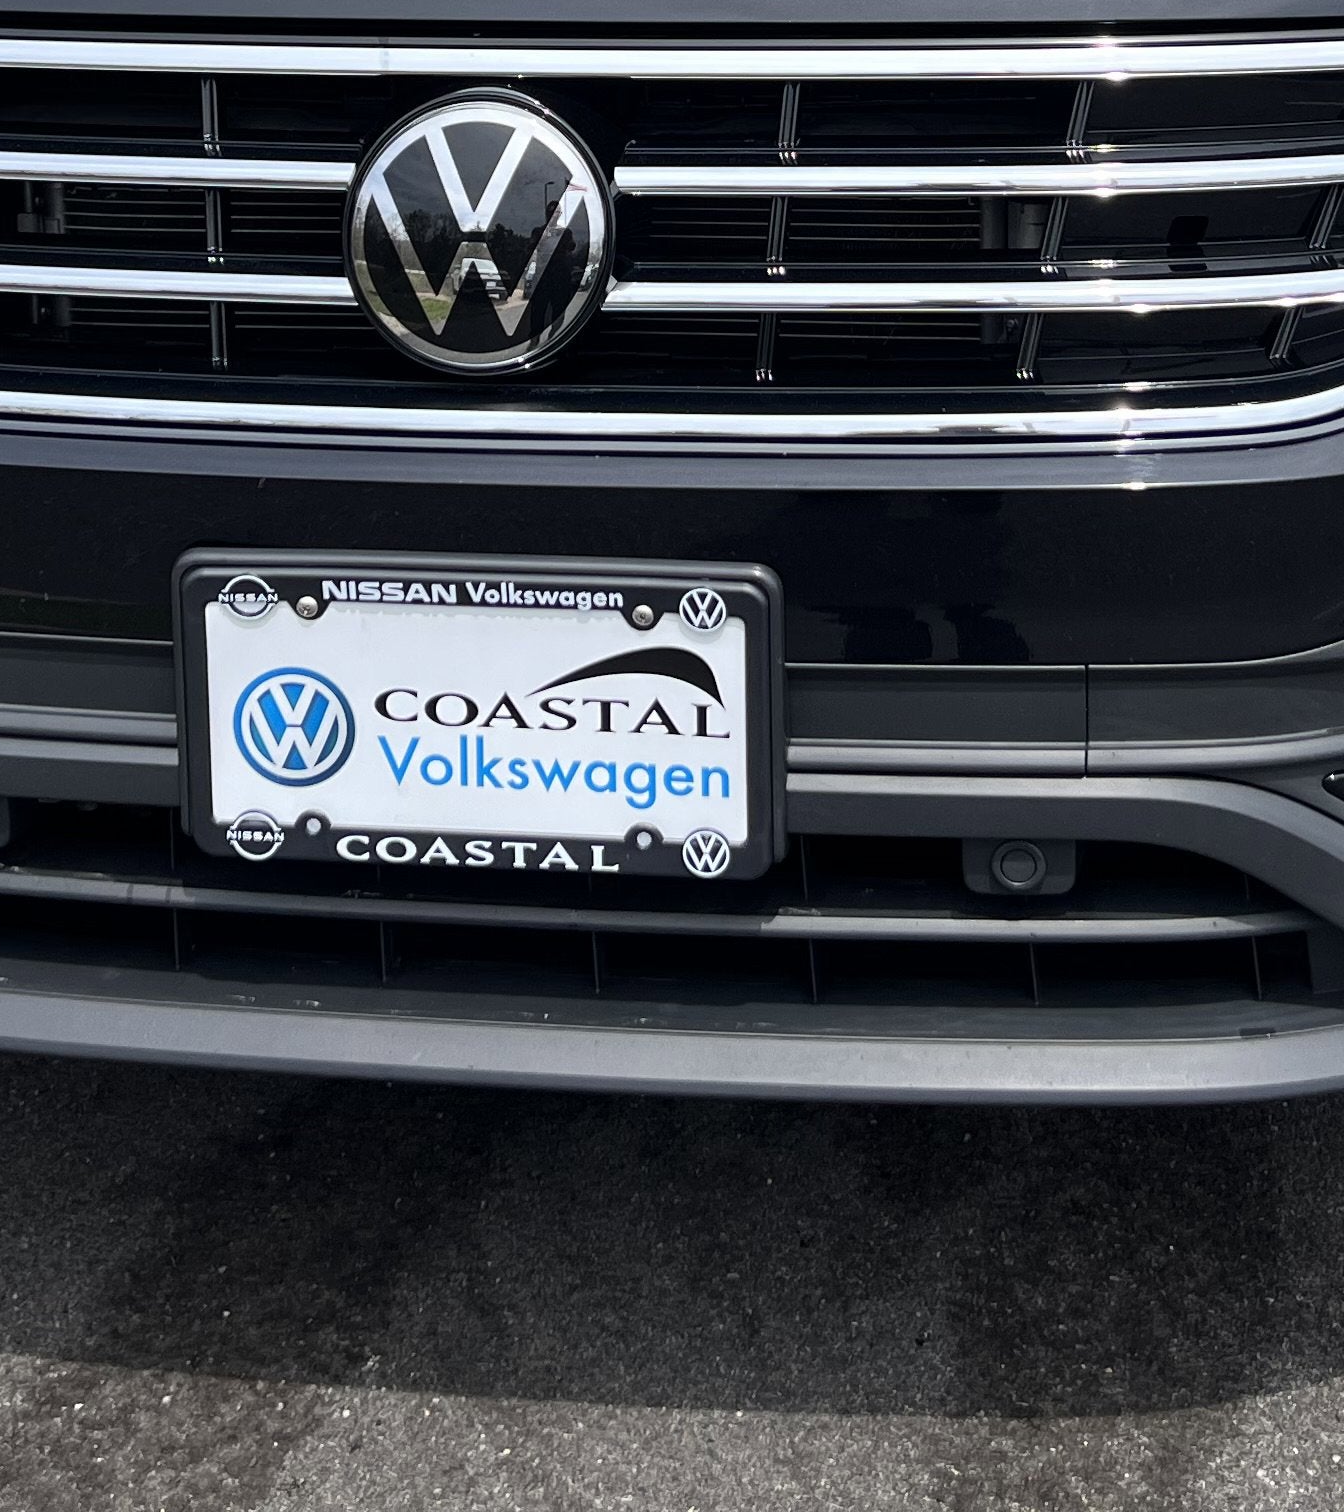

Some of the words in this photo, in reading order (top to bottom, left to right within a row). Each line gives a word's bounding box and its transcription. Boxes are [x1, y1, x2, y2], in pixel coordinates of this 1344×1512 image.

[218, 592, 278, 603] NISSAN
[322, 580, 457, 603] NISSAN
[465, 581, 624, 610] Volkswagen
[374, 688, 731, 739] COASTAL
[377, 734, 731, 809] Volkswagen
[226, 830, 285, 842] NISSAN
[336, 835, 619, 872] COASTAL
